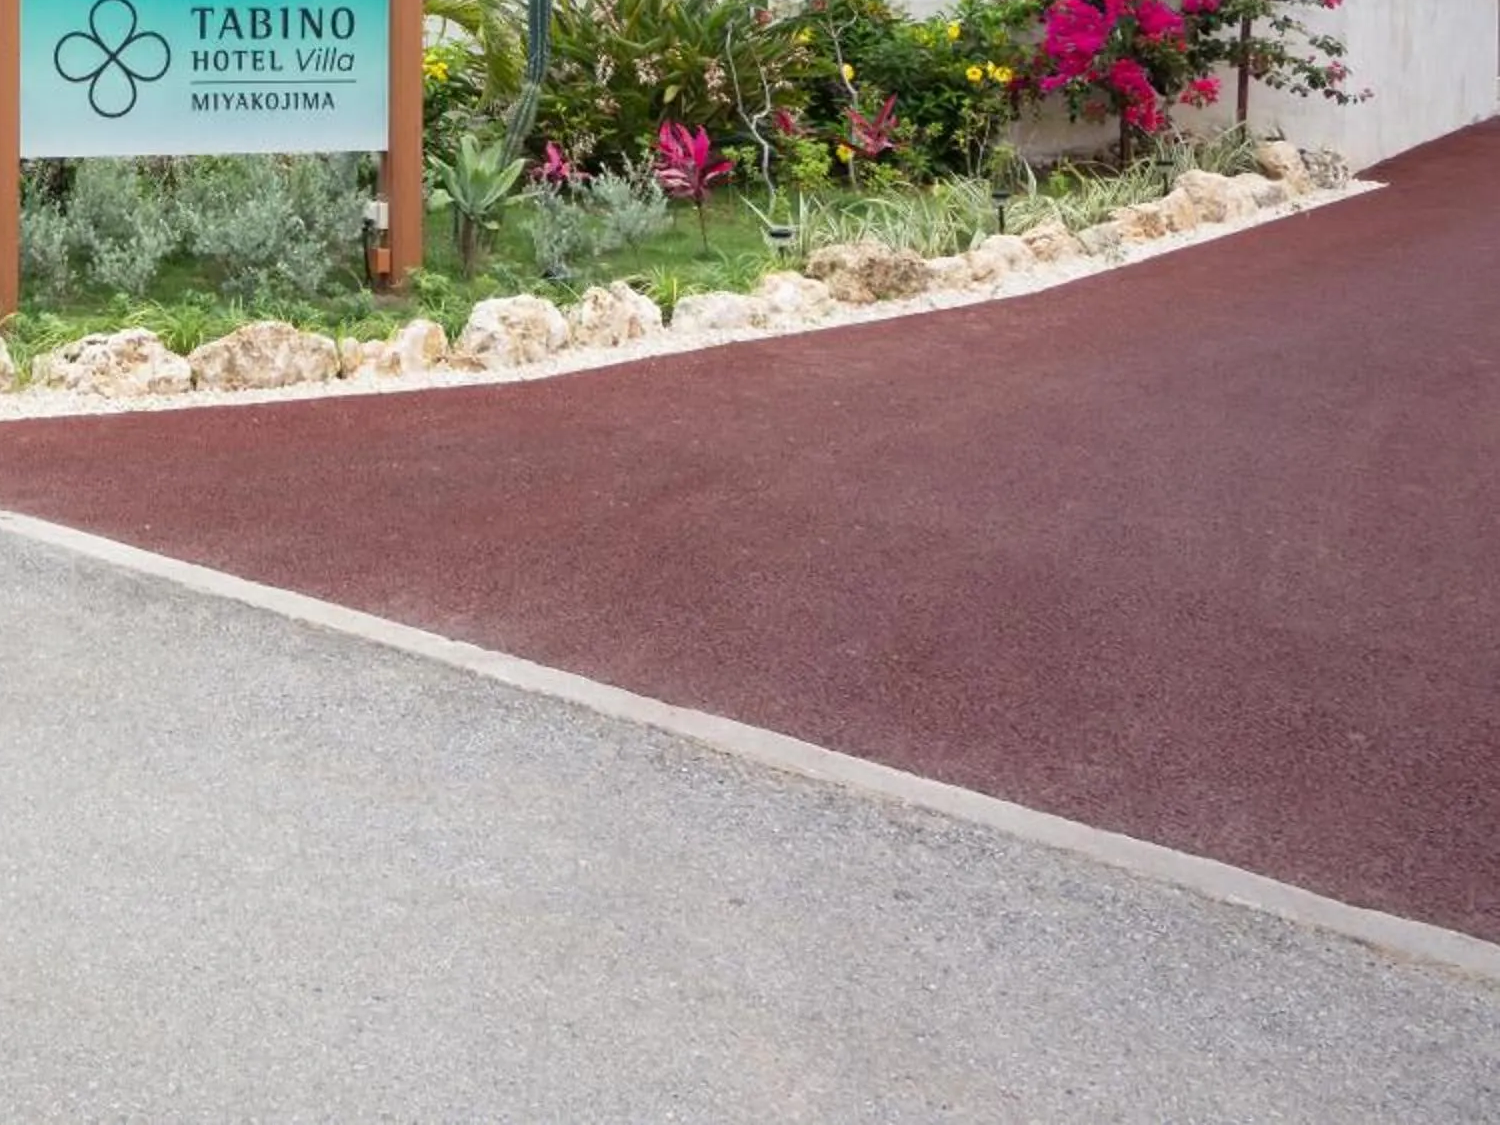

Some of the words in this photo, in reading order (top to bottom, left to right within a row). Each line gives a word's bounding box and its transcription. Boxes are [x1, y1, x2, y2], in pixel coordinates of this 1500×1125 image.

[190, 6, 356, 40] TABINO
[191, 50, 283, 72] HOTEL
[296, 47, 355, 72] Villa
[191, 91, 335, 112] MIYAKOJIMA
